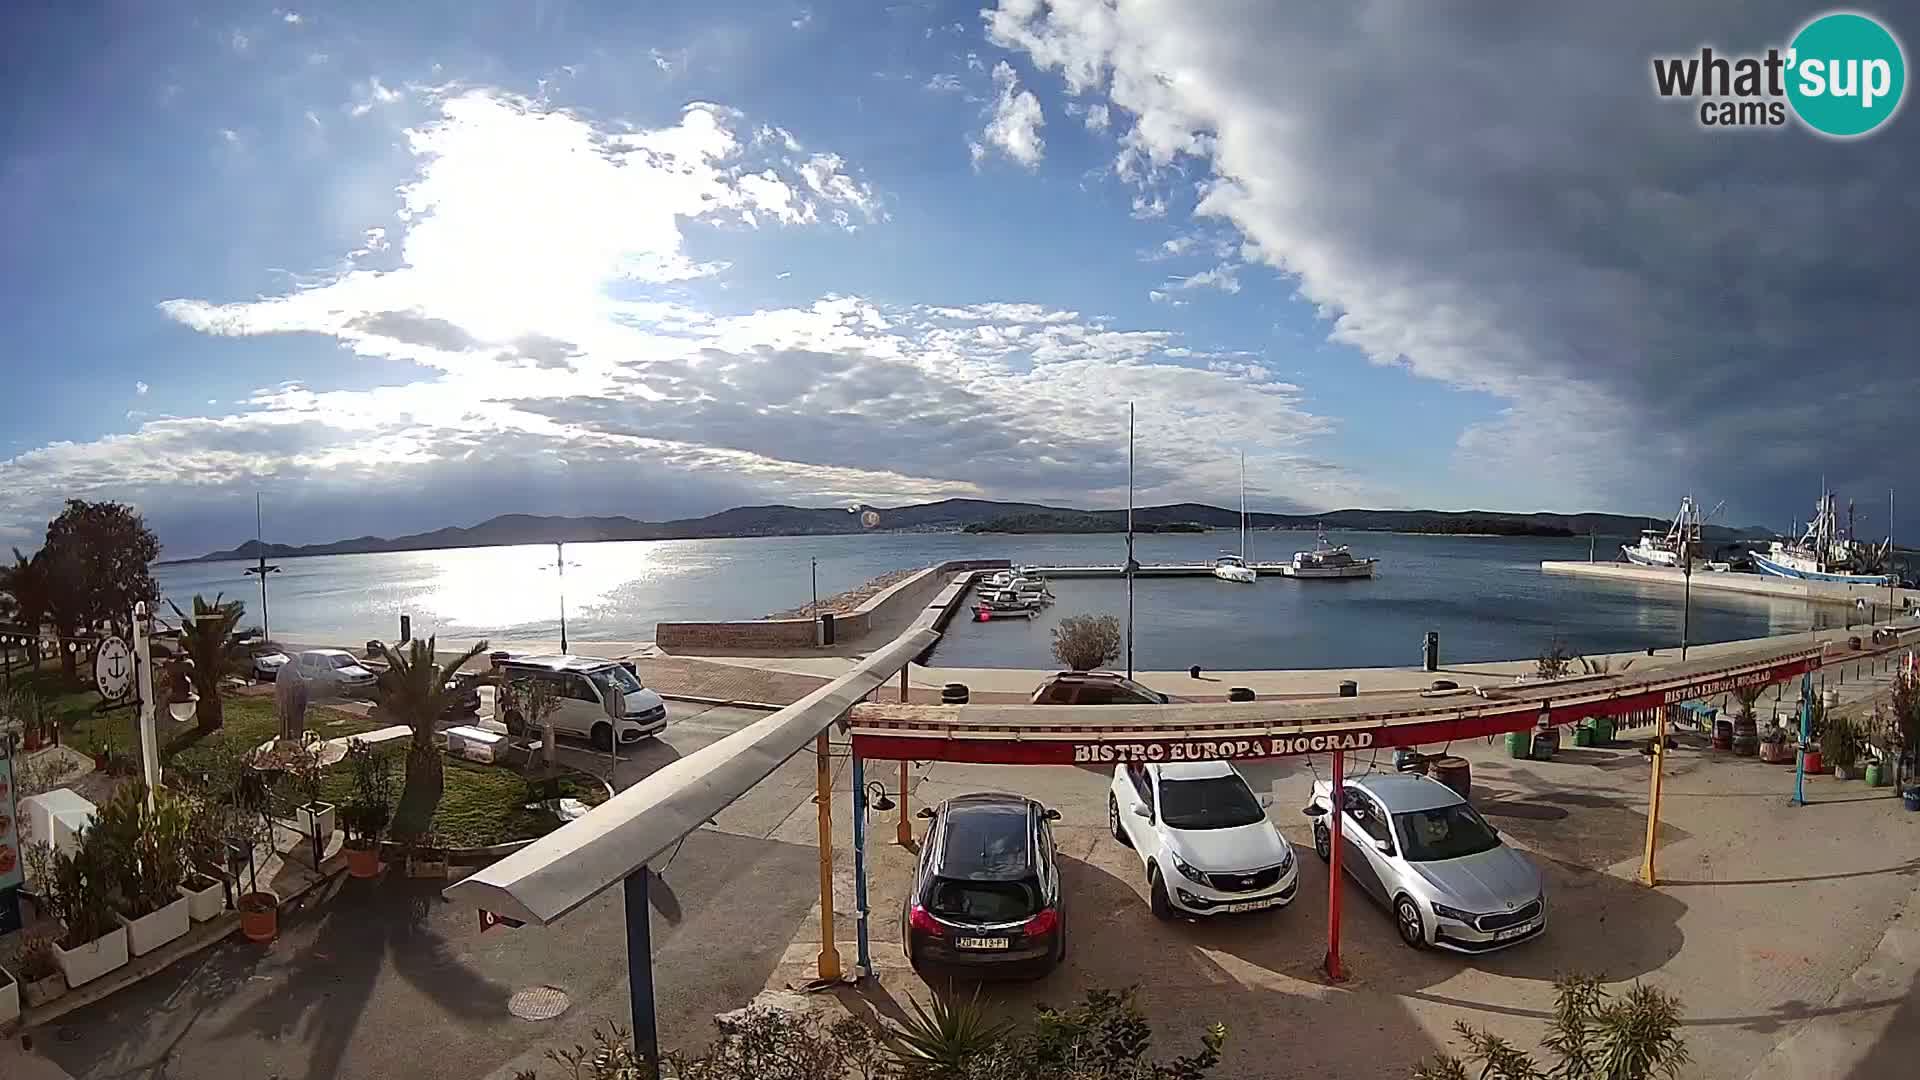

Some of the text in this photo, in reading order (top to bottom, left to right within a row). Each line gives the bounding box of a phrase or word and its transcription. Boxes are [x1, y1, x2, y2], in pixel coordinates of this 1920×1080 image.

[1664, 686, 1701, 703] BISTRO
[1701, 678, 1735, 697] EUROPA
[1074, 731, 1374, 763] BISTRO EUROPA BIOGRAD
